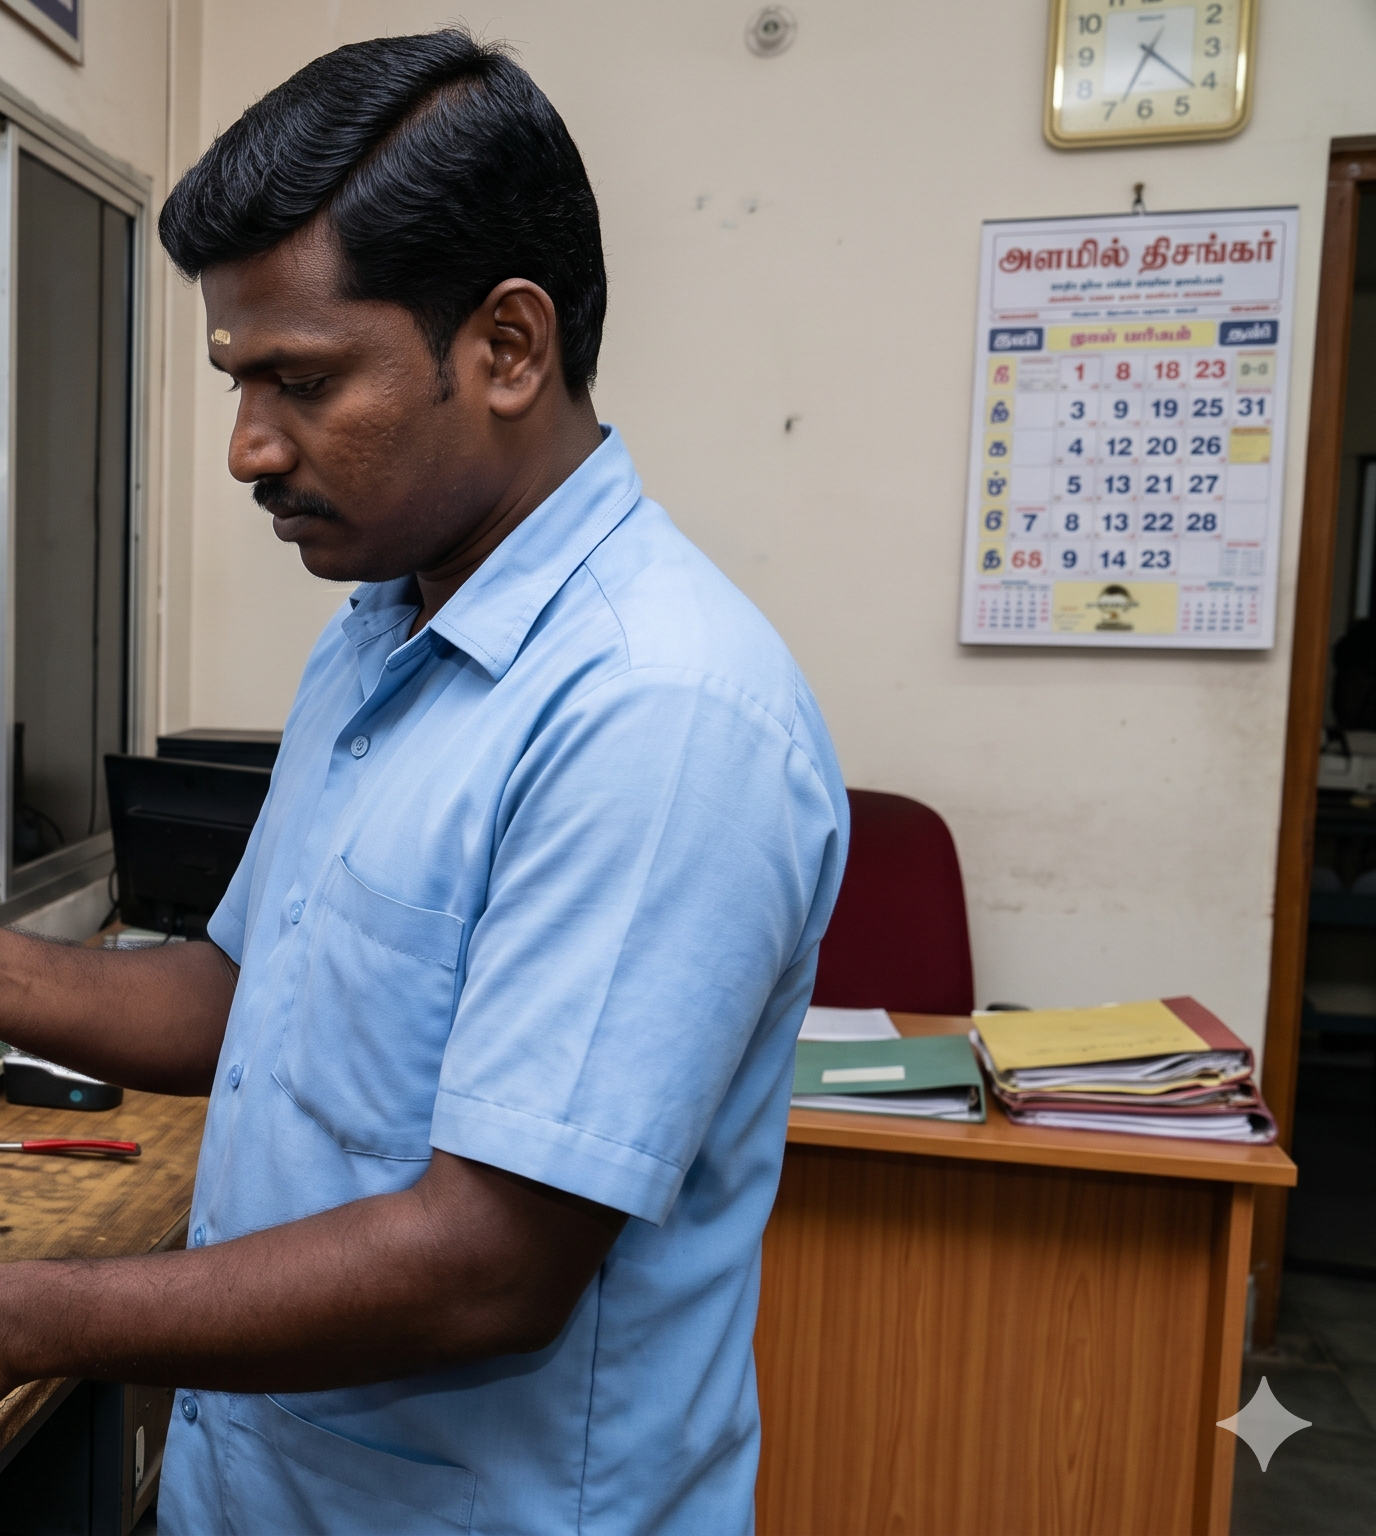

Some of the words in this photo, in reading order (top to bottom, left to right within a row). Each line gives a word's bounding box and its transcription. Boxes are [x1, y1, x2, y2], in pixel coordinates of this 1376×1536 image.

[1078, 13, 1102, 34] 10
[1206, 4, 1222, 25] 2
[1078, 46, 1094, 67] 9
[1204, 37, 1221, 58] 3
[1076, 79, 1093, 100] 8
[1200, 71, 1217, 90] 4
[1102, 102, 1118, 122] 7
[1137, 98, 1154, 120] 6
[1174, 96, 1190, 116] 5
[1074, 362, 1085, 381] 1
[1116, 362, 1131, 381] 8
[1154, 360, 1181, 380] 18
[1195, 360, 1226, 379] 23
[1070, 400, 1085, 420] 3
[1114, 400, 1128, 419] 9
[1152, 399, 1178, 418] 19
[1193, 398, 1223, 417] 25
[1238, 397, 1266, 416] 31
[1068, 438, 1084, 456] 4
[1106, 438, 1132, 456] 12
[1146, 437, 1177, 456] 20
[1190, 436, 1222, 454] 26
[1068, 476, 1081, 494] 5
[1104, 475, 1130, 494] 13
[1144, 475, 1174, 494] 21
[1188, 475, 1219, 494] 27
[1023, 514, 1037, 532] 7
[1064, 514, 1080, 532] 8
[1102, 514, 1128, 532] 13
[1142, 513, 1174, 532] 22
[1186, 513, 1217, 532] 28
[1011, 550, 1042, 568] 68
[1062, 550, 1077, 569] 9
[1100, 550, 1126, 568] 14
[1140, 550, 1172, 568] 23
